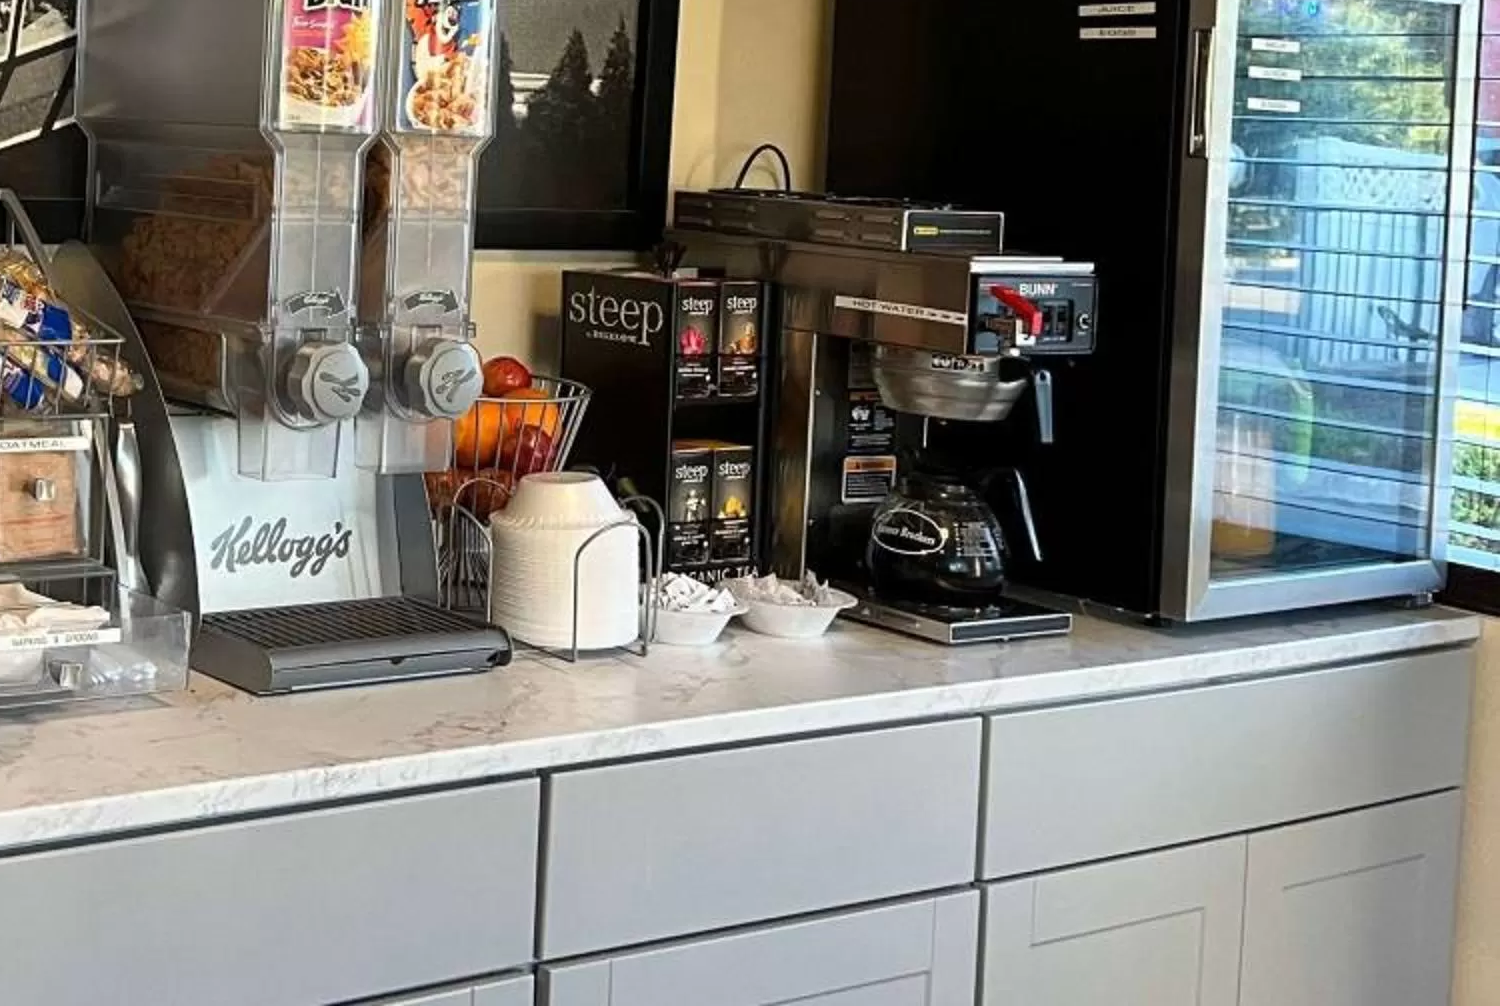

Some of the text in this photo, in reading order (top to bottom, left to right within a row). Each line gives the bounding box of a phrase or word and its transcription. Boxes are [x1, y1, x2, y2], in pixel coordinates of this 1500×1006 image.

[1019, 283, 1057, 297] BUNN
[681, 297, 714, 313] steep
[726, 295, 758, 313] steep
[880, 303, 925, 315] WATER
[569, 285, 664, 347] steep
[0, 439, 66, 451] OATMEAL
[675, 463, 709, 483] steep
[718, 460, 751, 478] steep
[209, 514, 353, 579] Kellogg's
[689, 565, 760, 584] GANIC TEA
